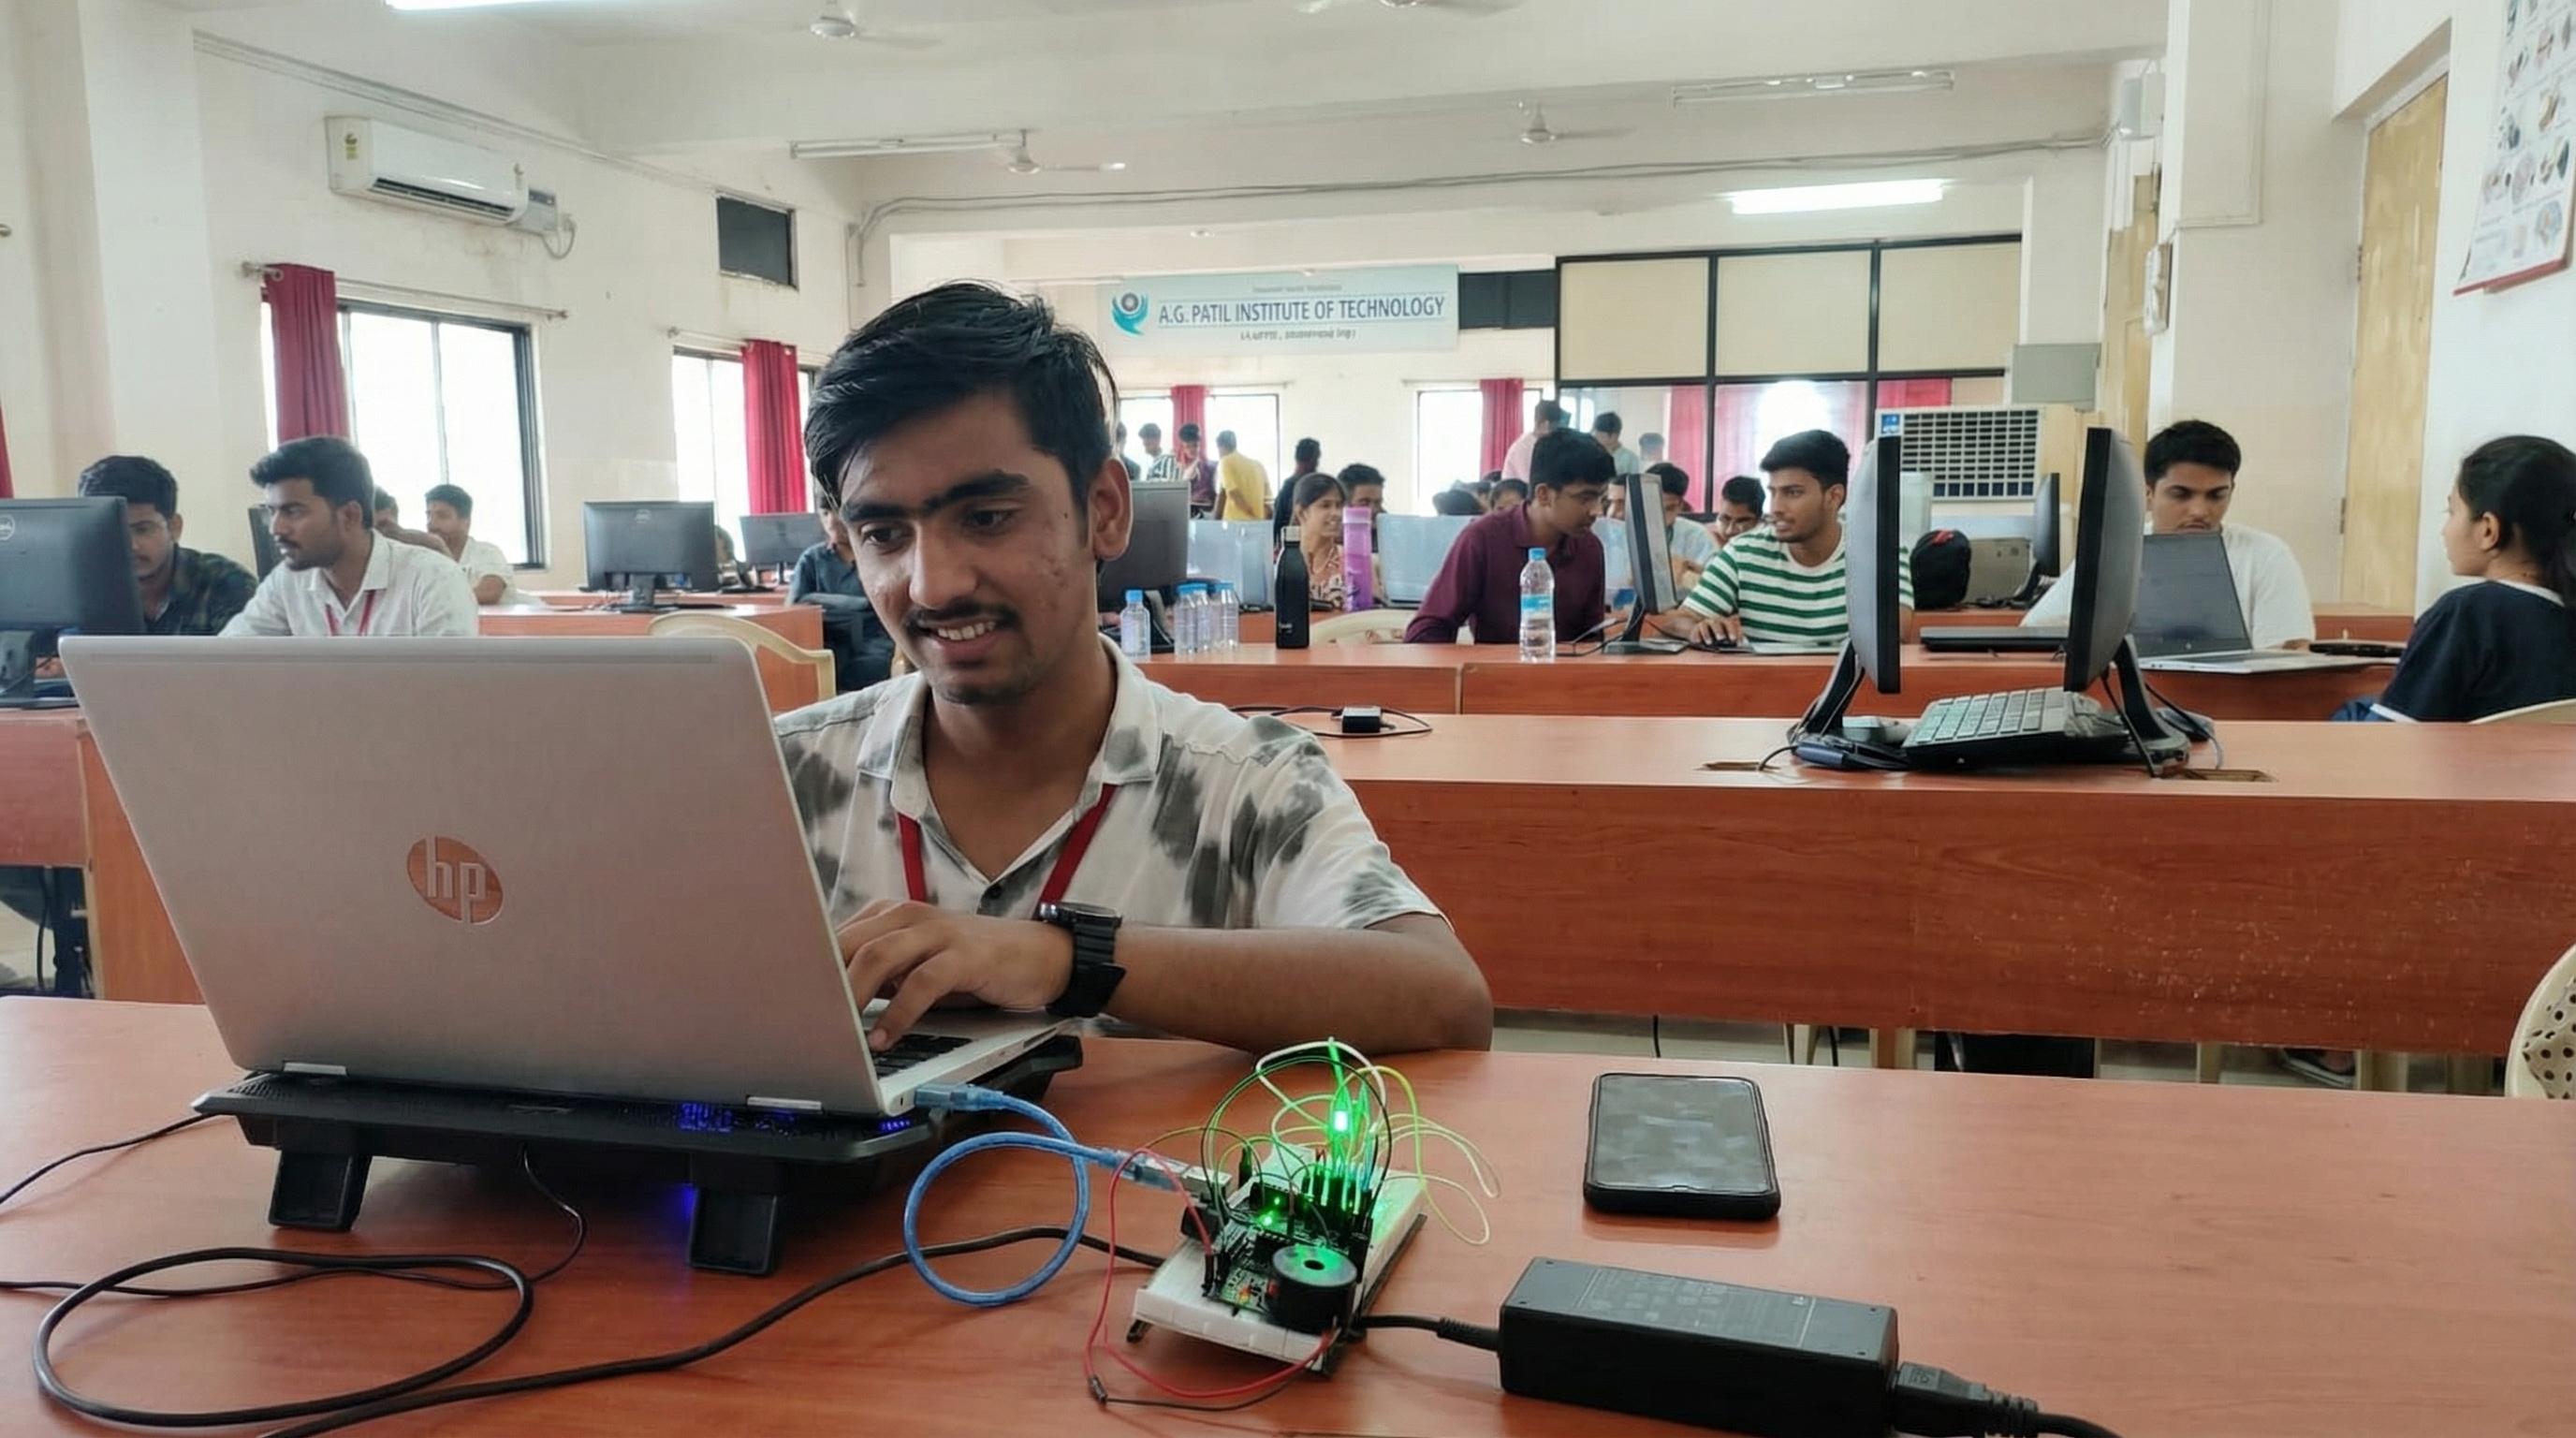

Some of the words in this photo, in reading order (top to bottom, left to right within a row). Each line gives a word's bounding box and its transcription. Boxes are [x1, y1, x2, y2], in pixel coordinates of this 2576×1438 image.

[1192, 303, 1232, 323] PATIL
[1235, 301, 1310, 322] INSTITUTE
[1314, 300, 1335, 320] OF
[1339, 296, 1445, 319] TECHNOLOGY
[426, 834, 487, 924] hp
